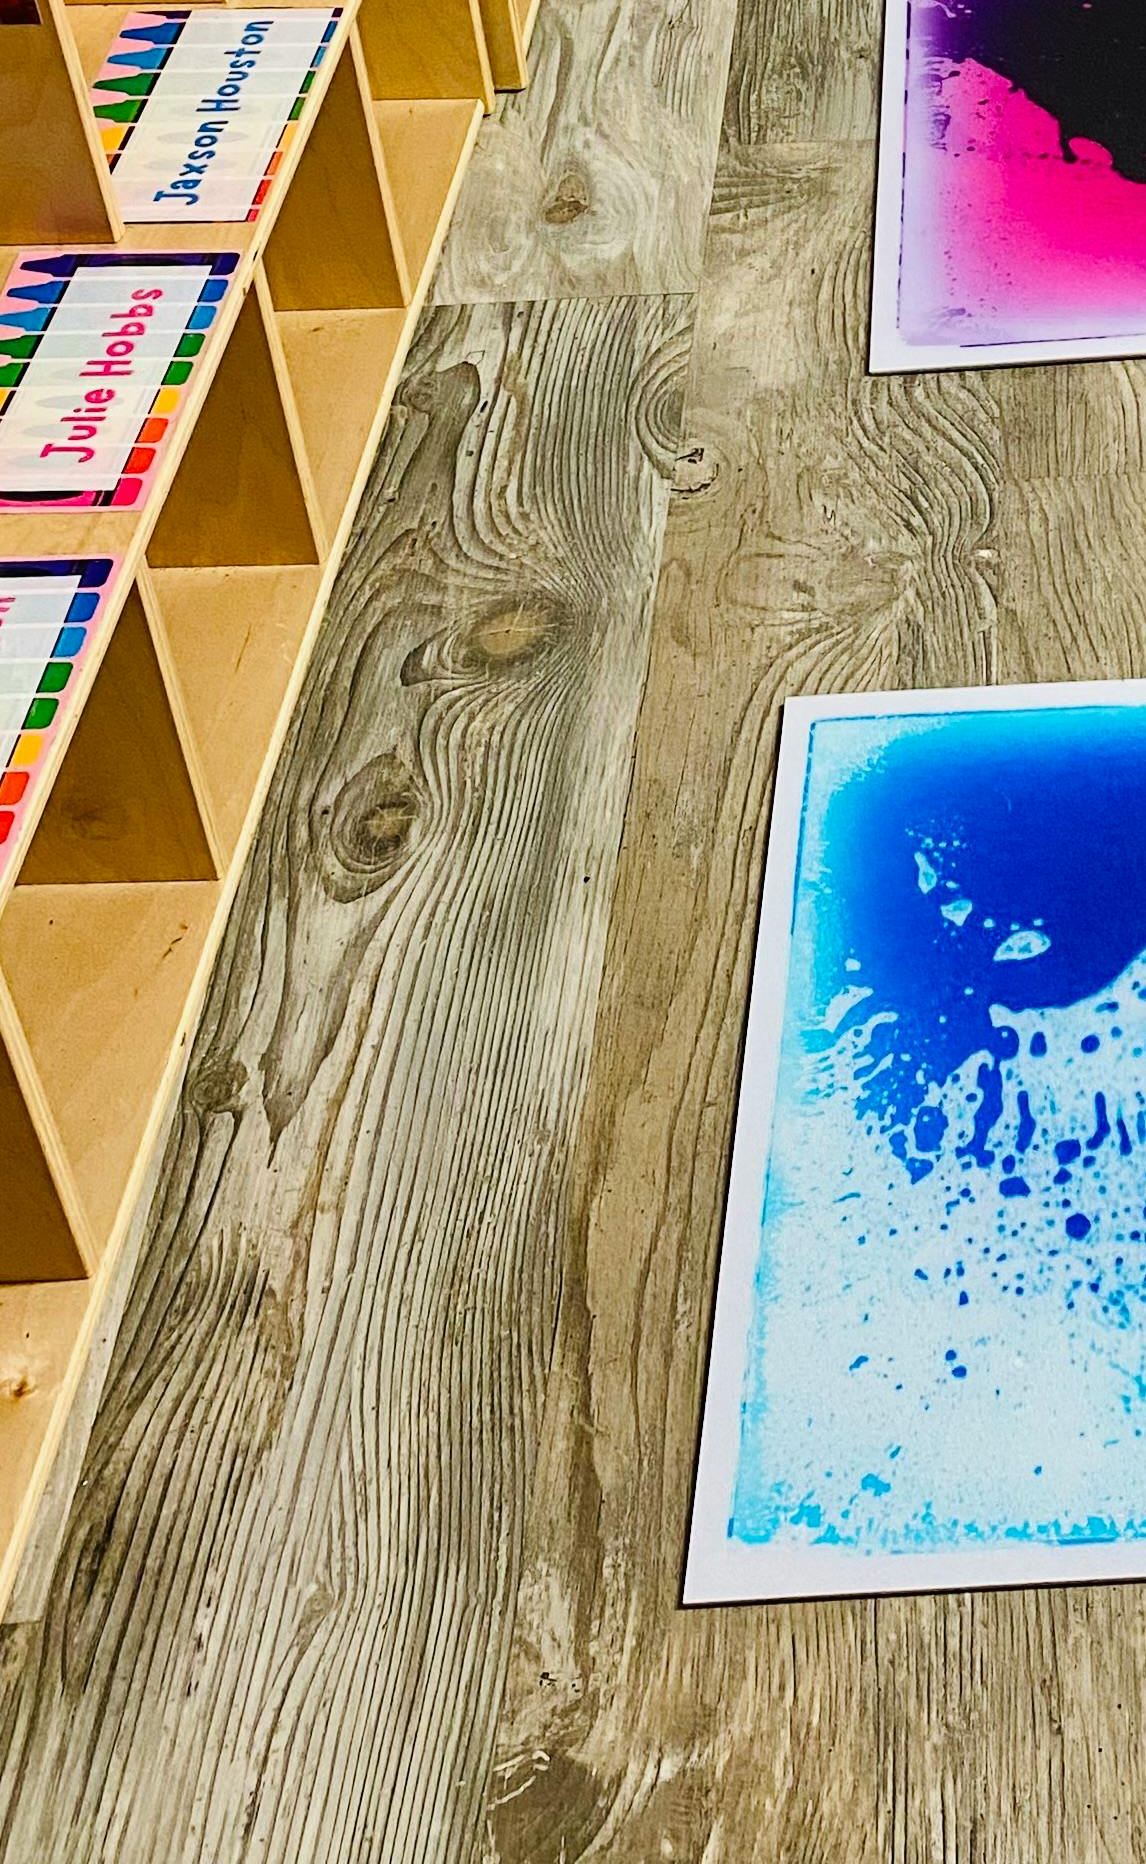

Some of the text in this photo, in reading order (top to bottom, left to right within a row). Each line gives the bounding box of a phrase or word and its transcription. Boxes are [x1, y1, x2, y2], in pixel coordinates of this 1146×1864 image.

[153, 21, 274, 206] Jaxson Houston
[40, 288, 163, 463] Julie Hobbs
